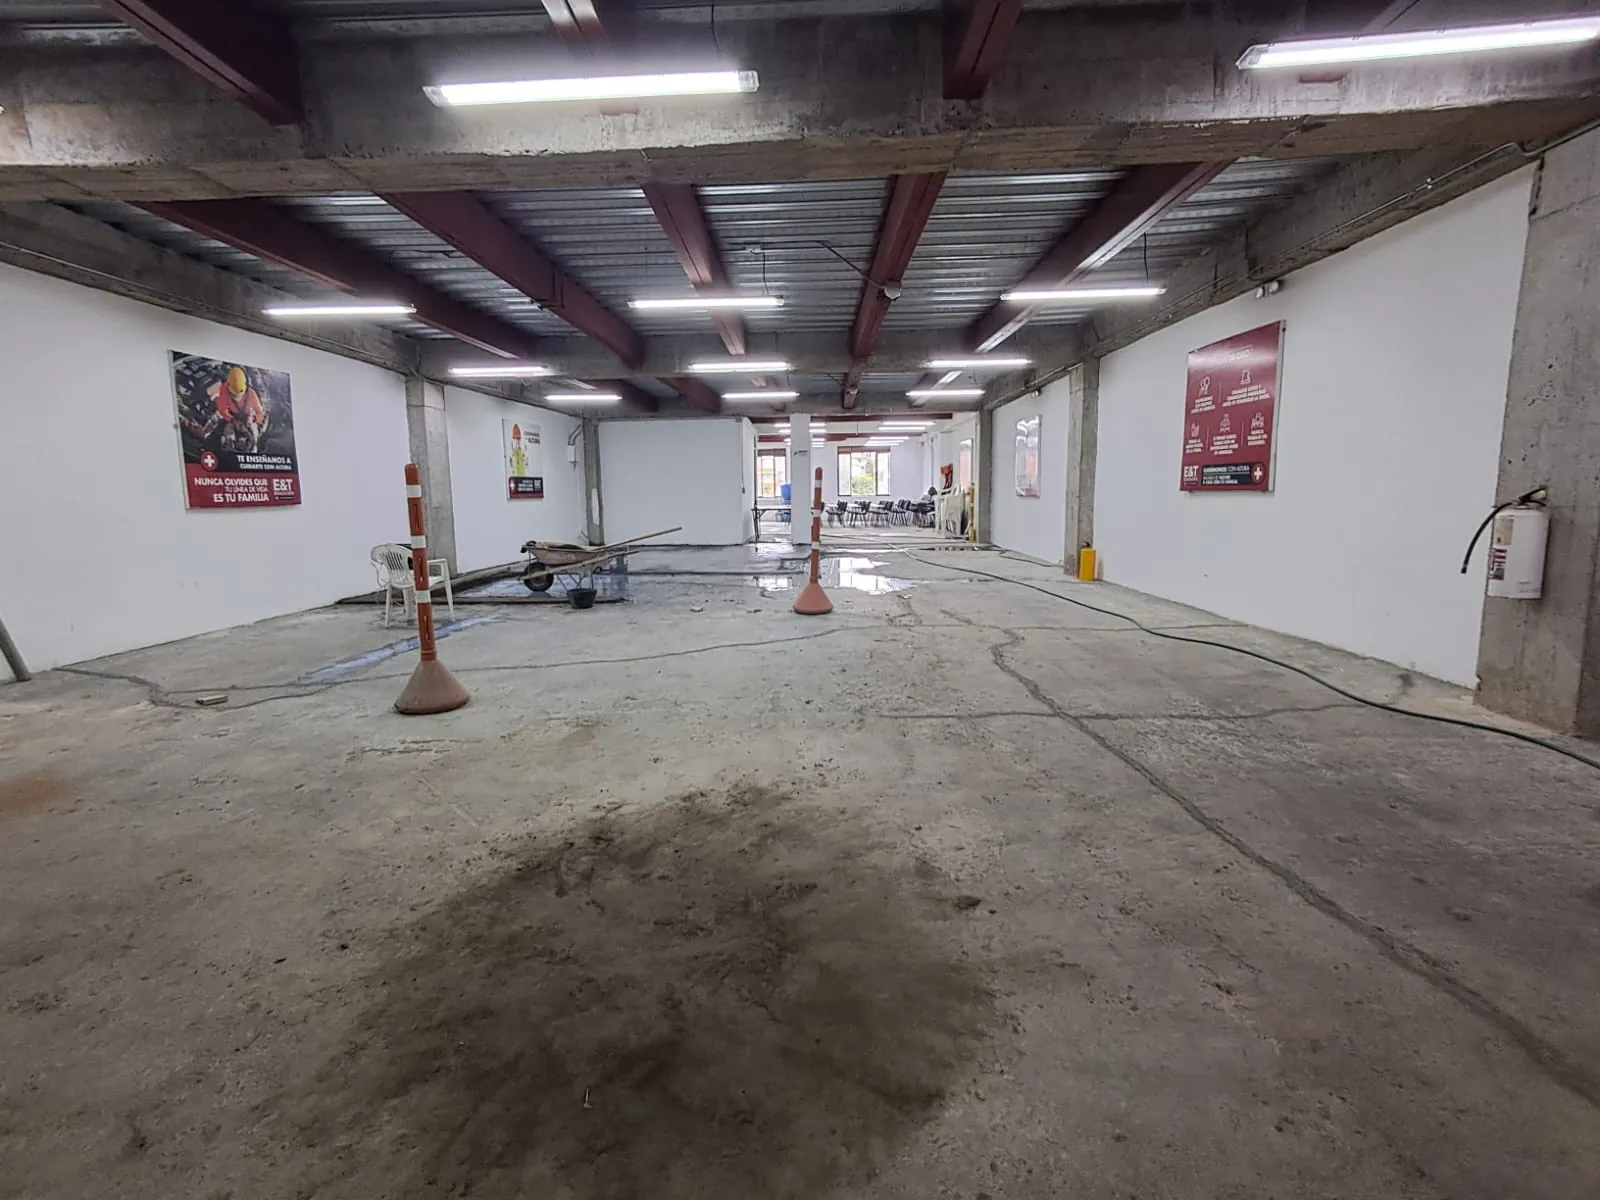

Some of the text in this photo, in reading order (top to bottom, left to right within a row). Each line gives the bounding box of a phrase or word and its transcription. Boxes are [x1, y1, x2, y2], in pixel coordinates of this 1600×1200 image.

[237, 454, 245, 463] TE
[246, 454, 285, 464] ENSEÑAMOS
[1184, 465, 1199, 477] E&T
[194, 477, 268, 486] NUNCA OLVIDES QUE
[273, 479, 293, 491] E&T
[213, 493, 224, 502] ES
[224, 493, 237, 502] TU
[238, 493, 270, 502] FAMILIA
